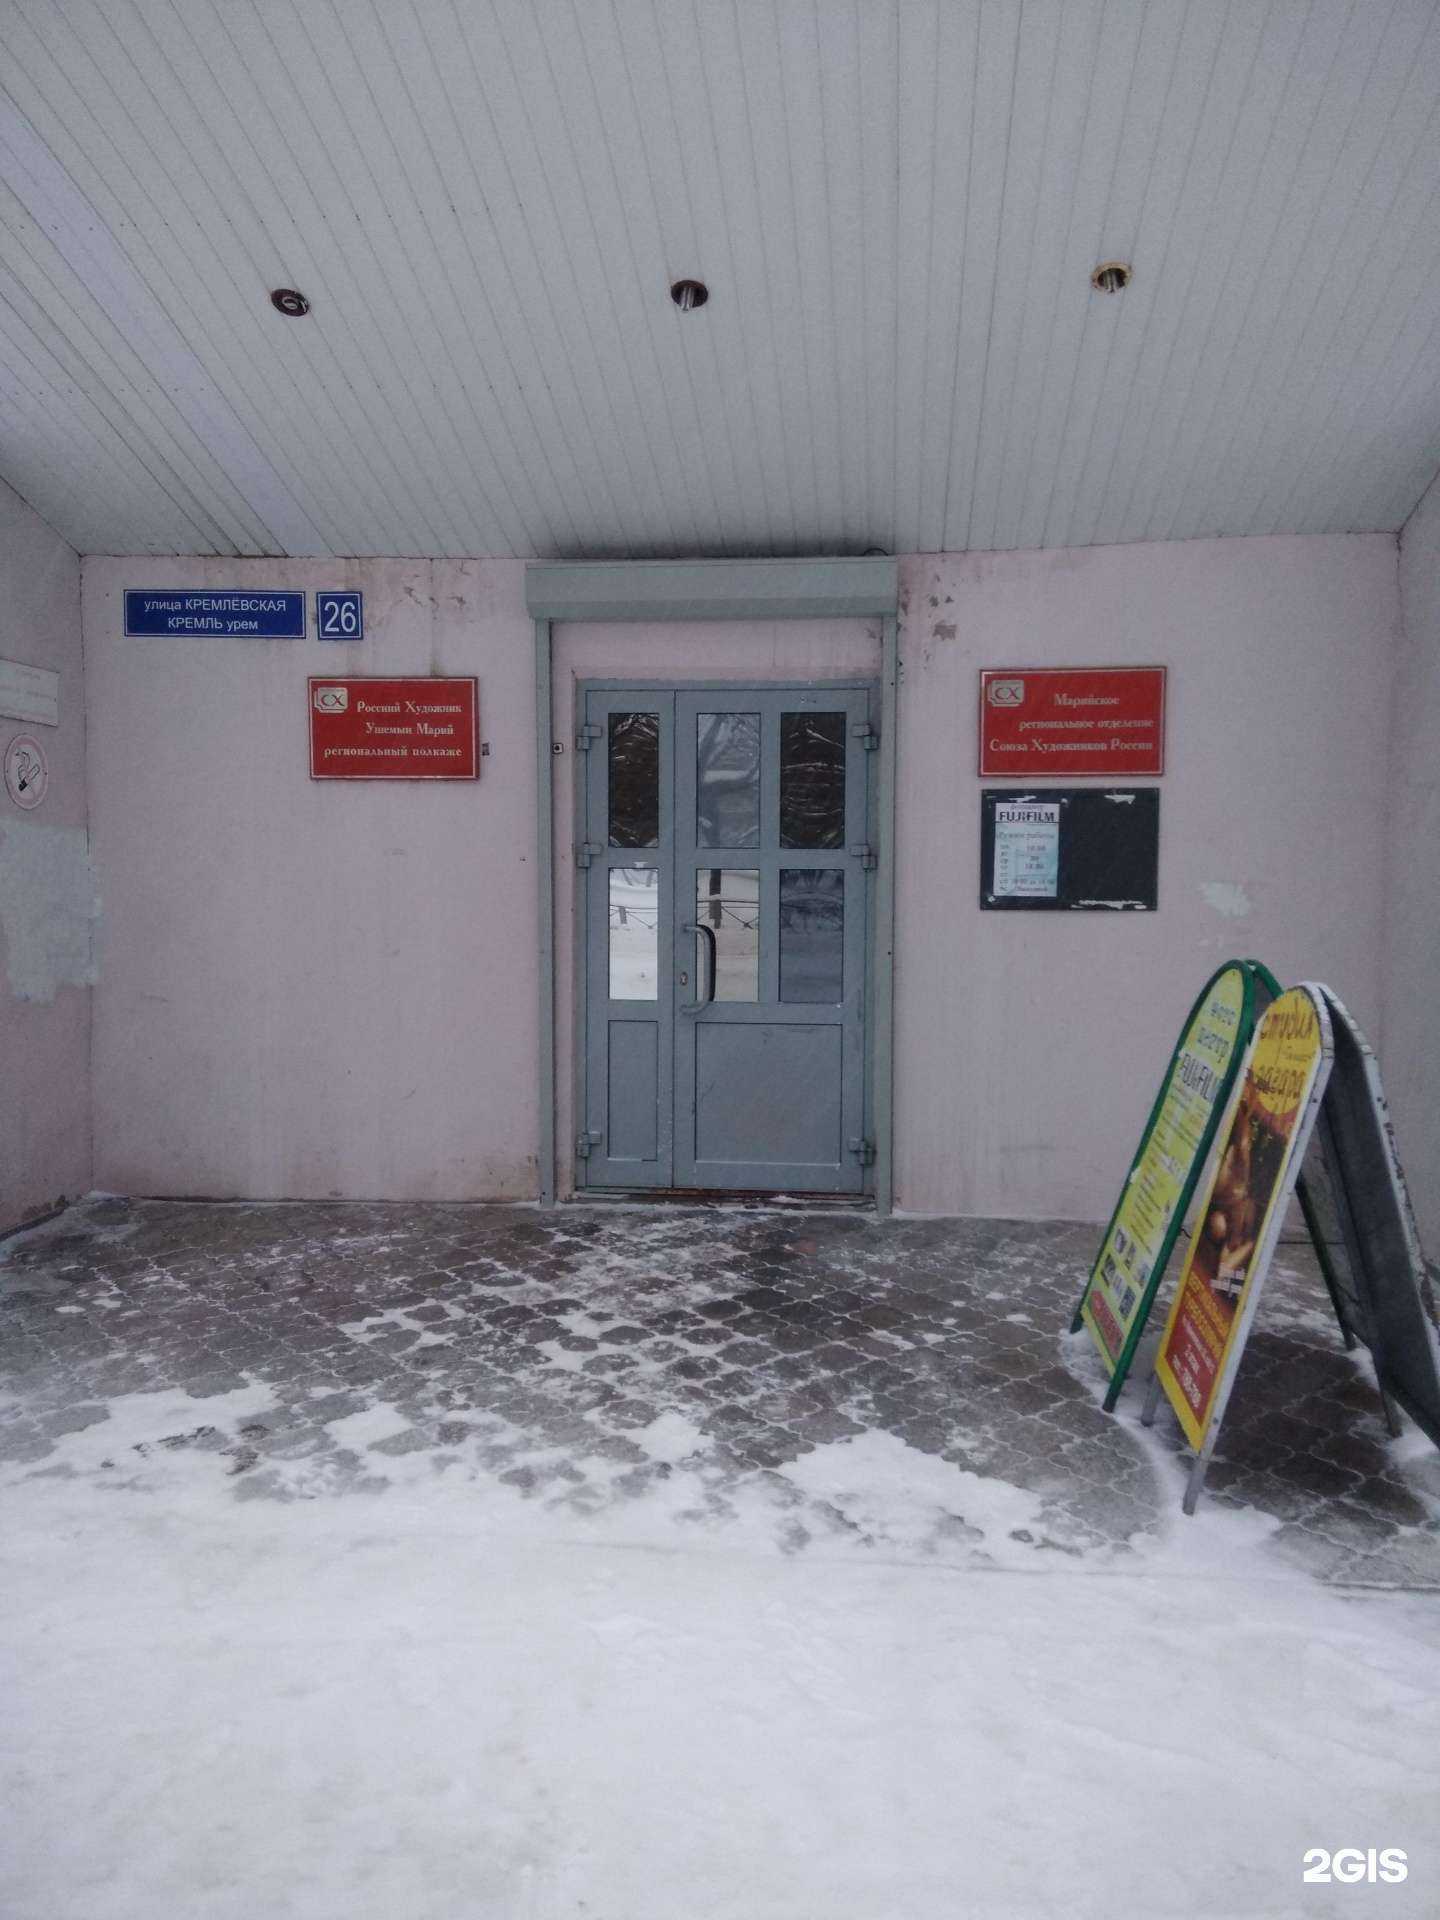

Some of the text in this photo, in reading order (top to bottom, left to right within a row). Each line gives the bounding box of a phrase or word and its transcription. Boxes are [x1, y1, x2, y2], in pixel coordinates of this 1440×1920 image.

[144, 597, 286, 612] улица КРЕМЛЁВСКАЯ
[168, 617, 258, 632] КРЕМЛЬ урем
[324, 601, 356, 633] 26
[405, 701, 463, 716] Художник
[1054, 693, 1120, 709] Марийское
[416, 722, 455, 738] Марий
[1019, 718, 1154, 732] региональное отделение
[324, 745, 409, 759] региональный
[989, 737, 1153, 754] Союза Художников России
[998, 810, 1056, 823] FUJIFILM
